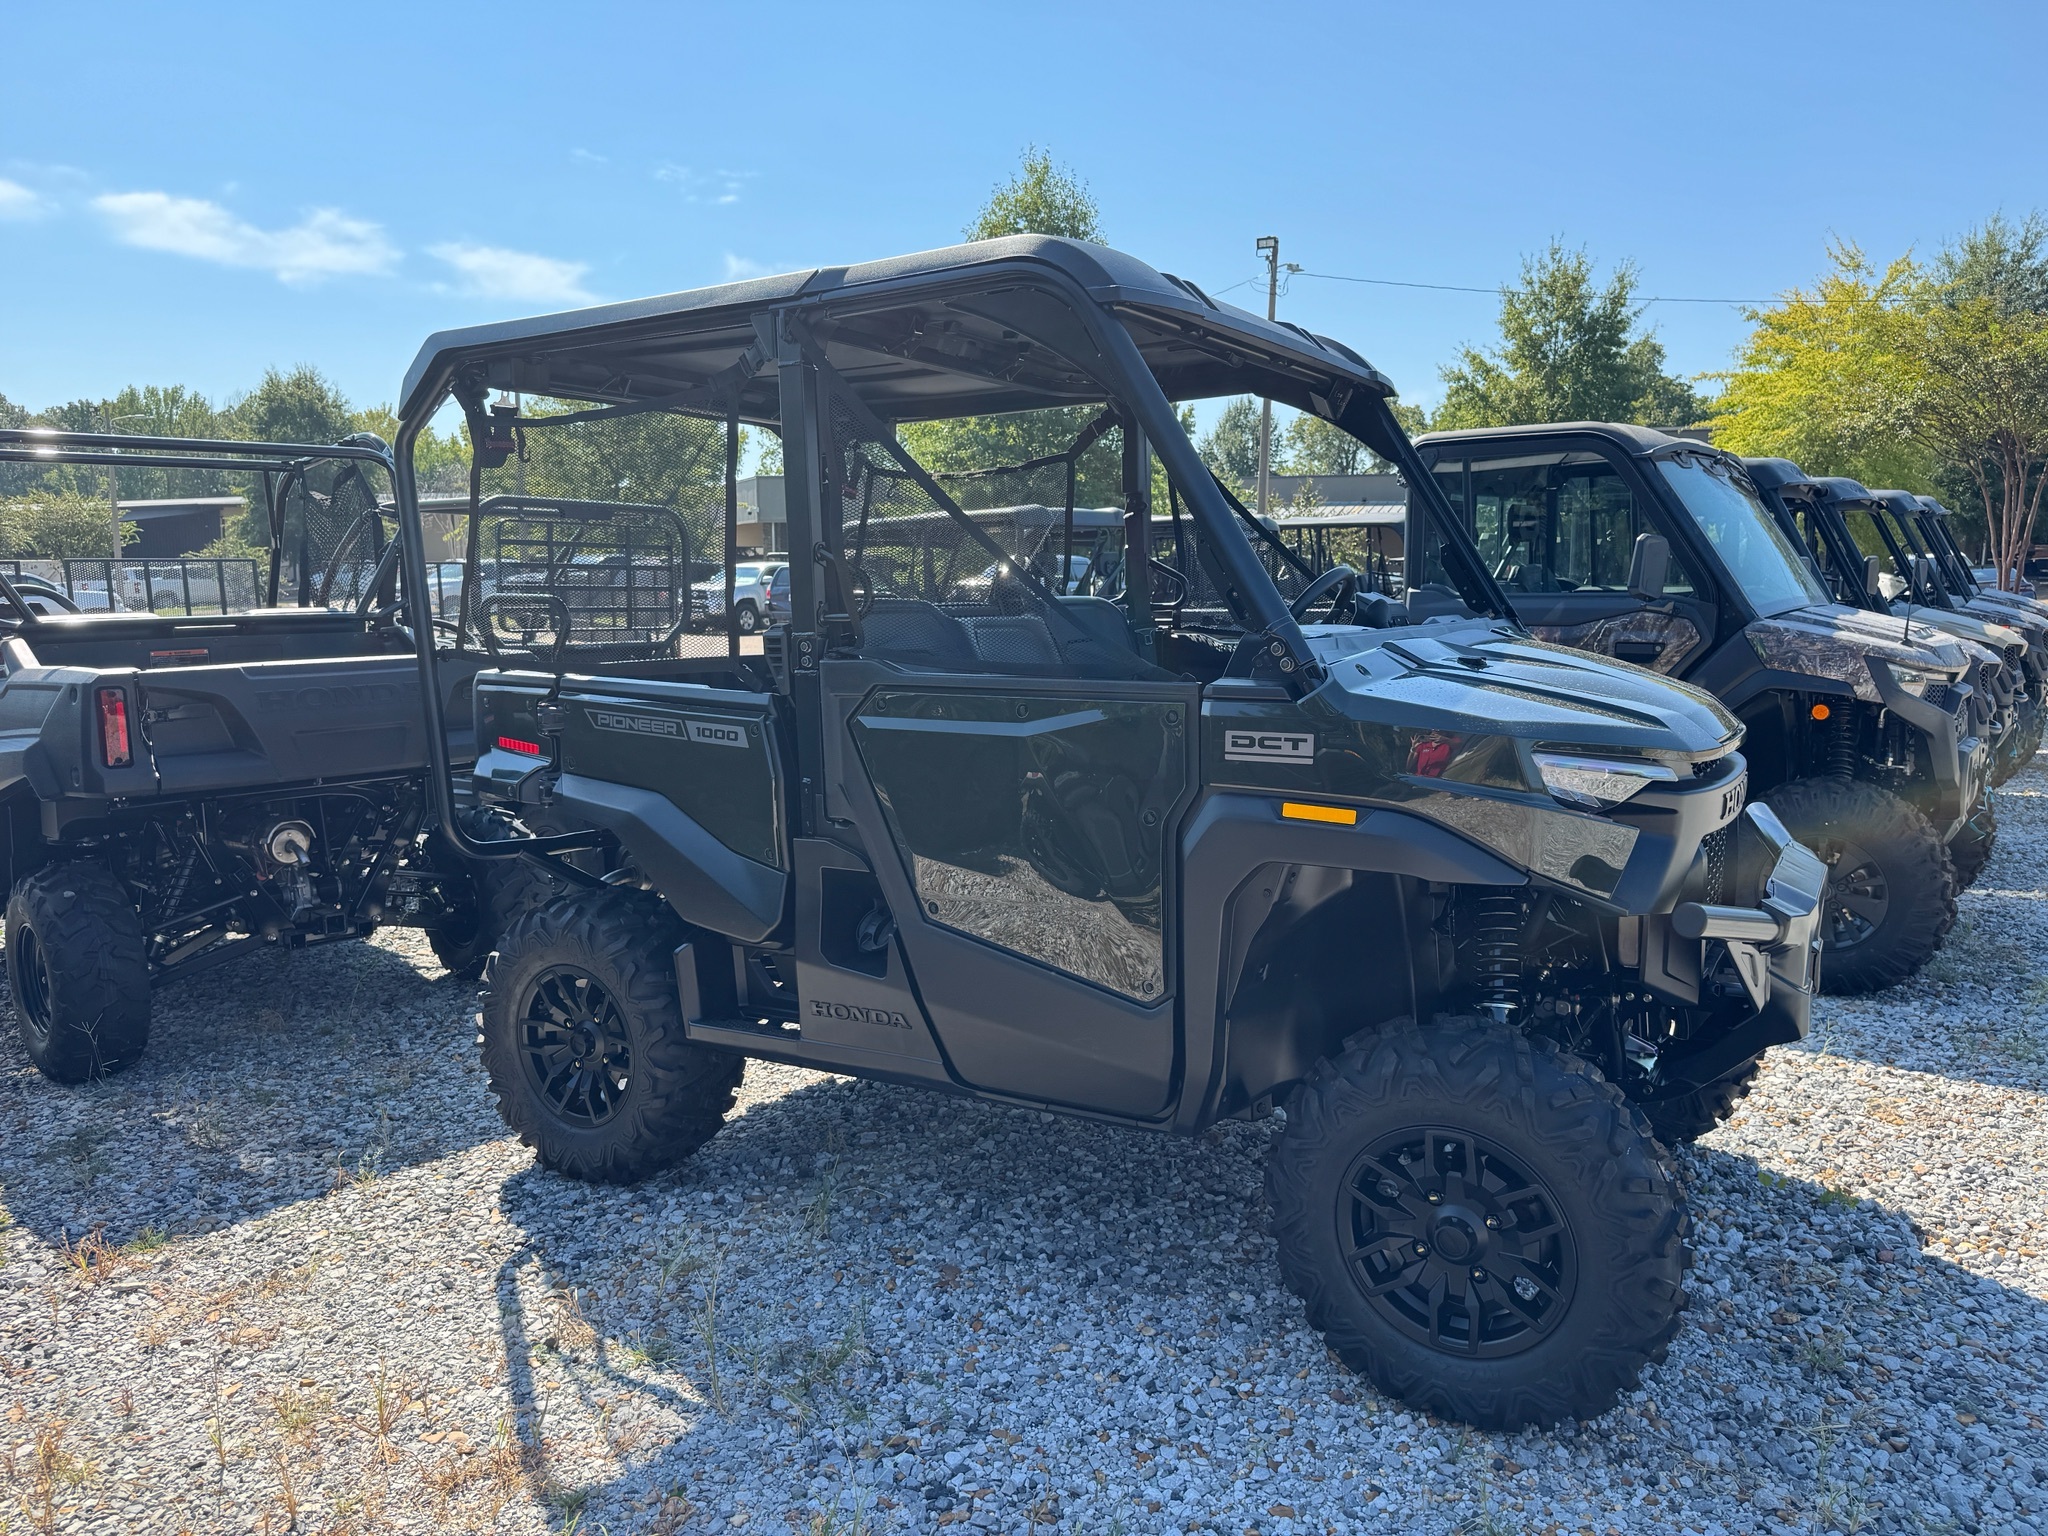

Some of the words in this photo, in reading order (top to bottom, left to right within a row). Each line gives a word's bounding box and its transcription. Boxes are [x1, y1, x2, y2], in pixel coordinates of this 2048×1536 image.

[597, 713, 677, 735] PIONEER
[695, 726, 739, 742] 1000
[1231, 734, 1308, 751] DCT
[809, 1000, 913, 1030] HONDA
